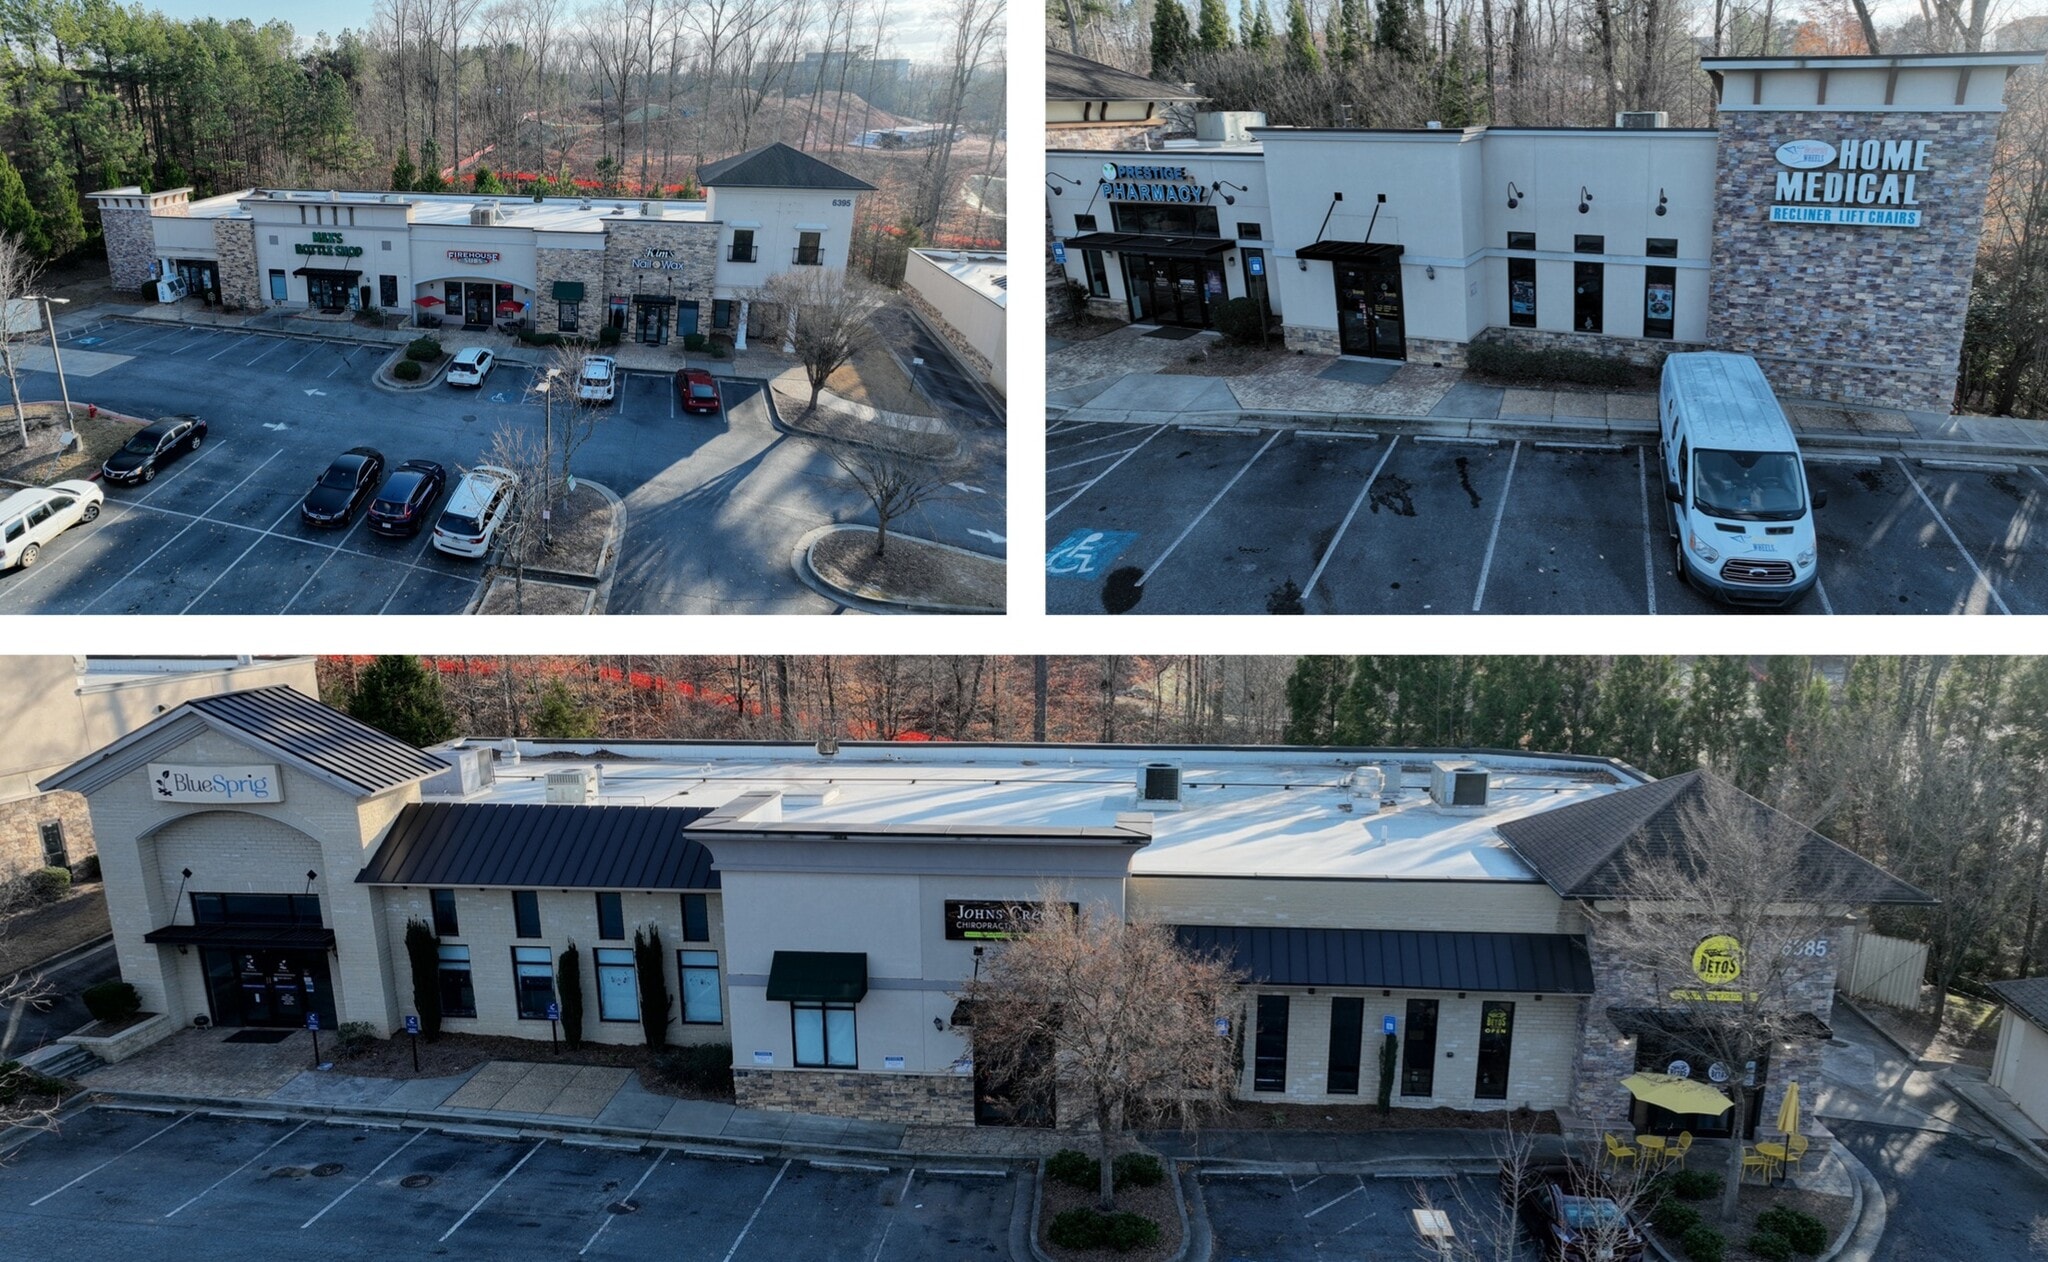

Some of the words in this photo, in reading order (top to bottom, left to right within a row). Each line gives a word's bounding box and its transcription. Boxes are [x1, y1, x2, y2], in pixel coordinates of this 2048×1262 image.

[1839, 139, 1933, 171] HOME
[1116, 165, 1187, 181] PRESTIGE
[1102, 182, 1204, 203] PHARMACY
[1775, 171, 1920, 206] MEDICAL
[832, 199, 852, 207] 6395
[1774, 207, 1831, 222] RECLINER
[1839, 210, 1864, 223] LIFT
[1868, 211, 1916, 225] CHAIRS
[295, 243, 334, 256] BOTTLE
[335, 245, 363, 257] SHOP
[448, 251, 499, 262] FIREHOUSE
[632, 259, 652, 269] Nail
[661, 260, 685, 271] Wax
[173, 772, 269, 799] BlueSprig
[1700, 954, 1737, 975] BETOS
